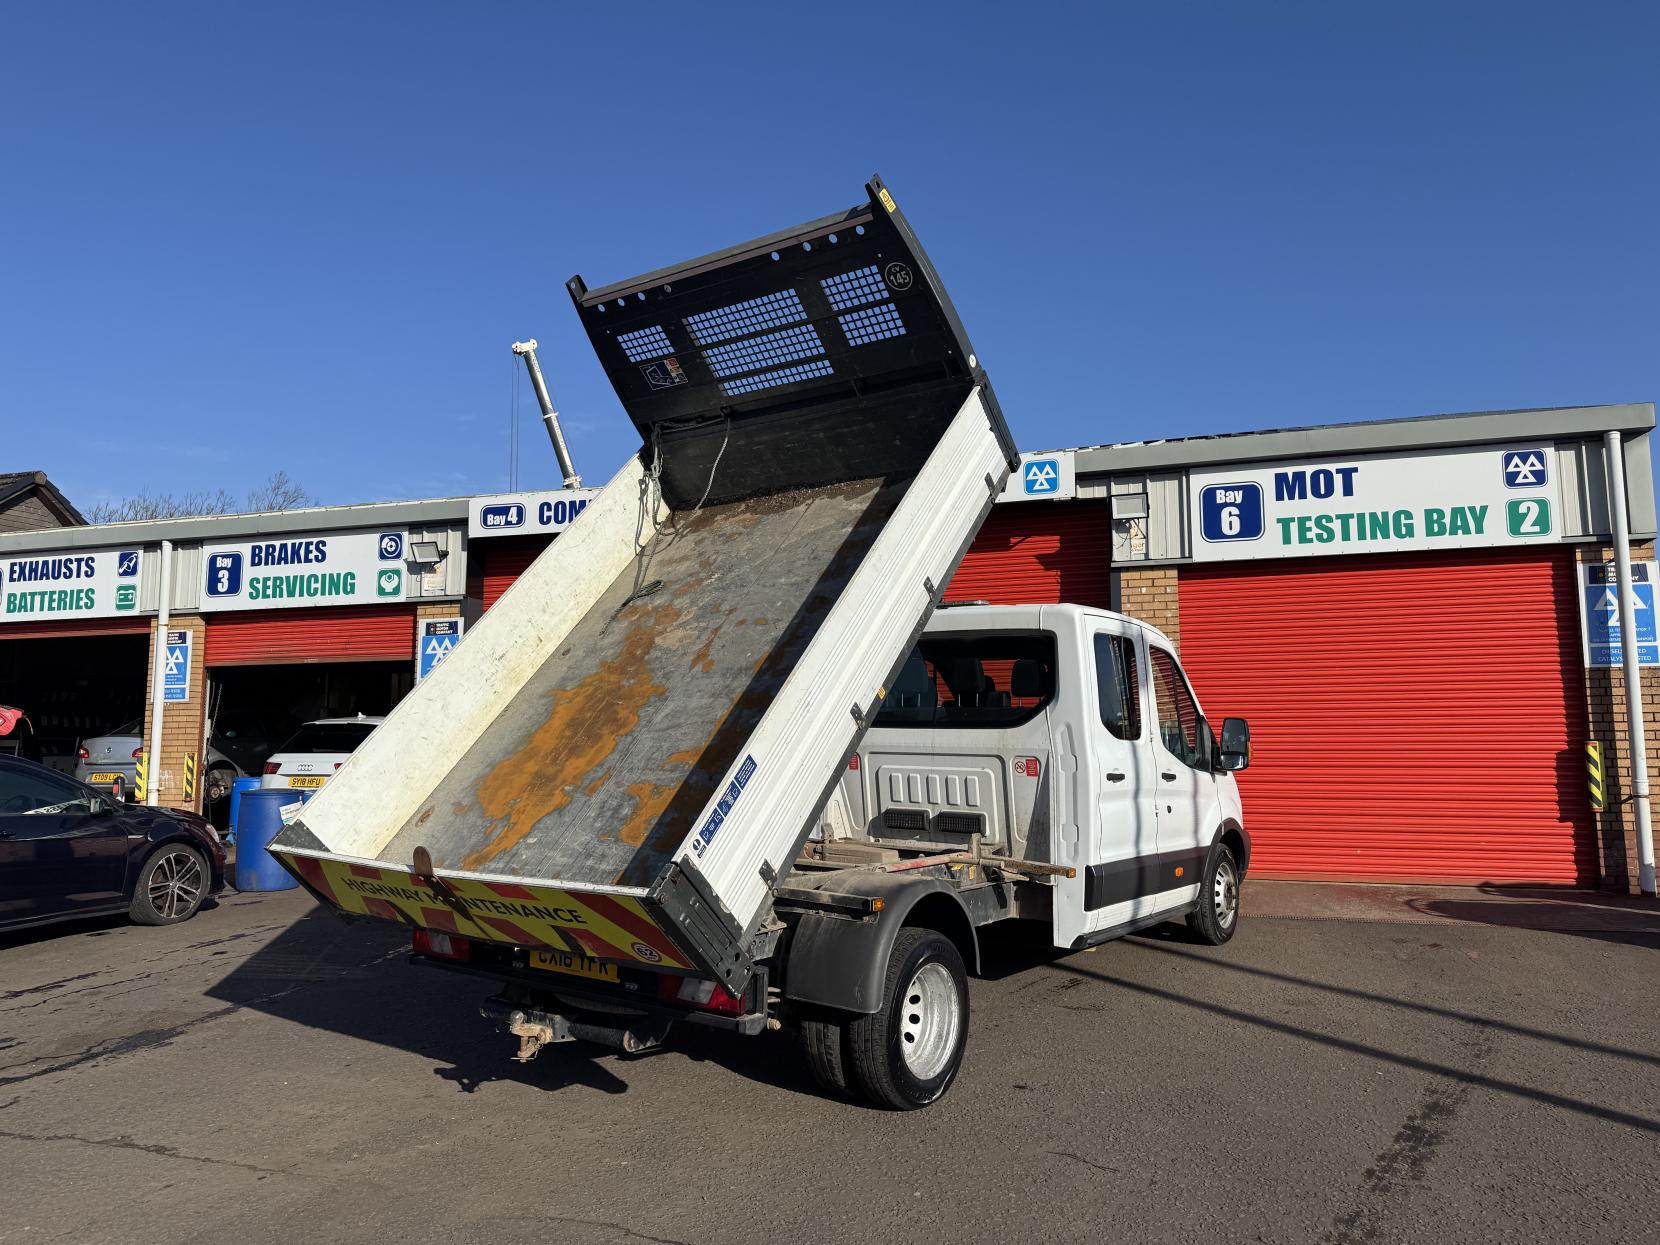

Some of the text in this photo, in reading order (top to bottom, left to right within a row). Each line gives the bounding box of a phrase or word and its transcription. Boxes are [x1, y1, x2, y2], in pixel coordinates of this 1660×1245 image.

[890, 271, 910, 286] 145
[1216, 489, 1243, 504] Bay
[1274, 467, 1359, 501] MOT
[487, 507, 518, 526] Bay 4
[538, 500, 593, 526] COM
[1221, 506, 1240, 536] 6
[1276, 505, 1488, 545] TESTING BAY
[1518, 501, 1540, 533] 2
[216, 556, 232, 569] Bay
[250, 540, 327, 567] BRAKES
[9, 556, 95, 582] EXHAUSTS
[217, 570, 229, 593] 3
[249, 572, 356, 600] SERVICING
[6, 588, 95, 613] BATTERIES
[292, 777, 321, 786] SY18 HFU
[340, 877, 588, 924] HIGHWAY MNTENANCE
[636, 947, 657, 957] 62
